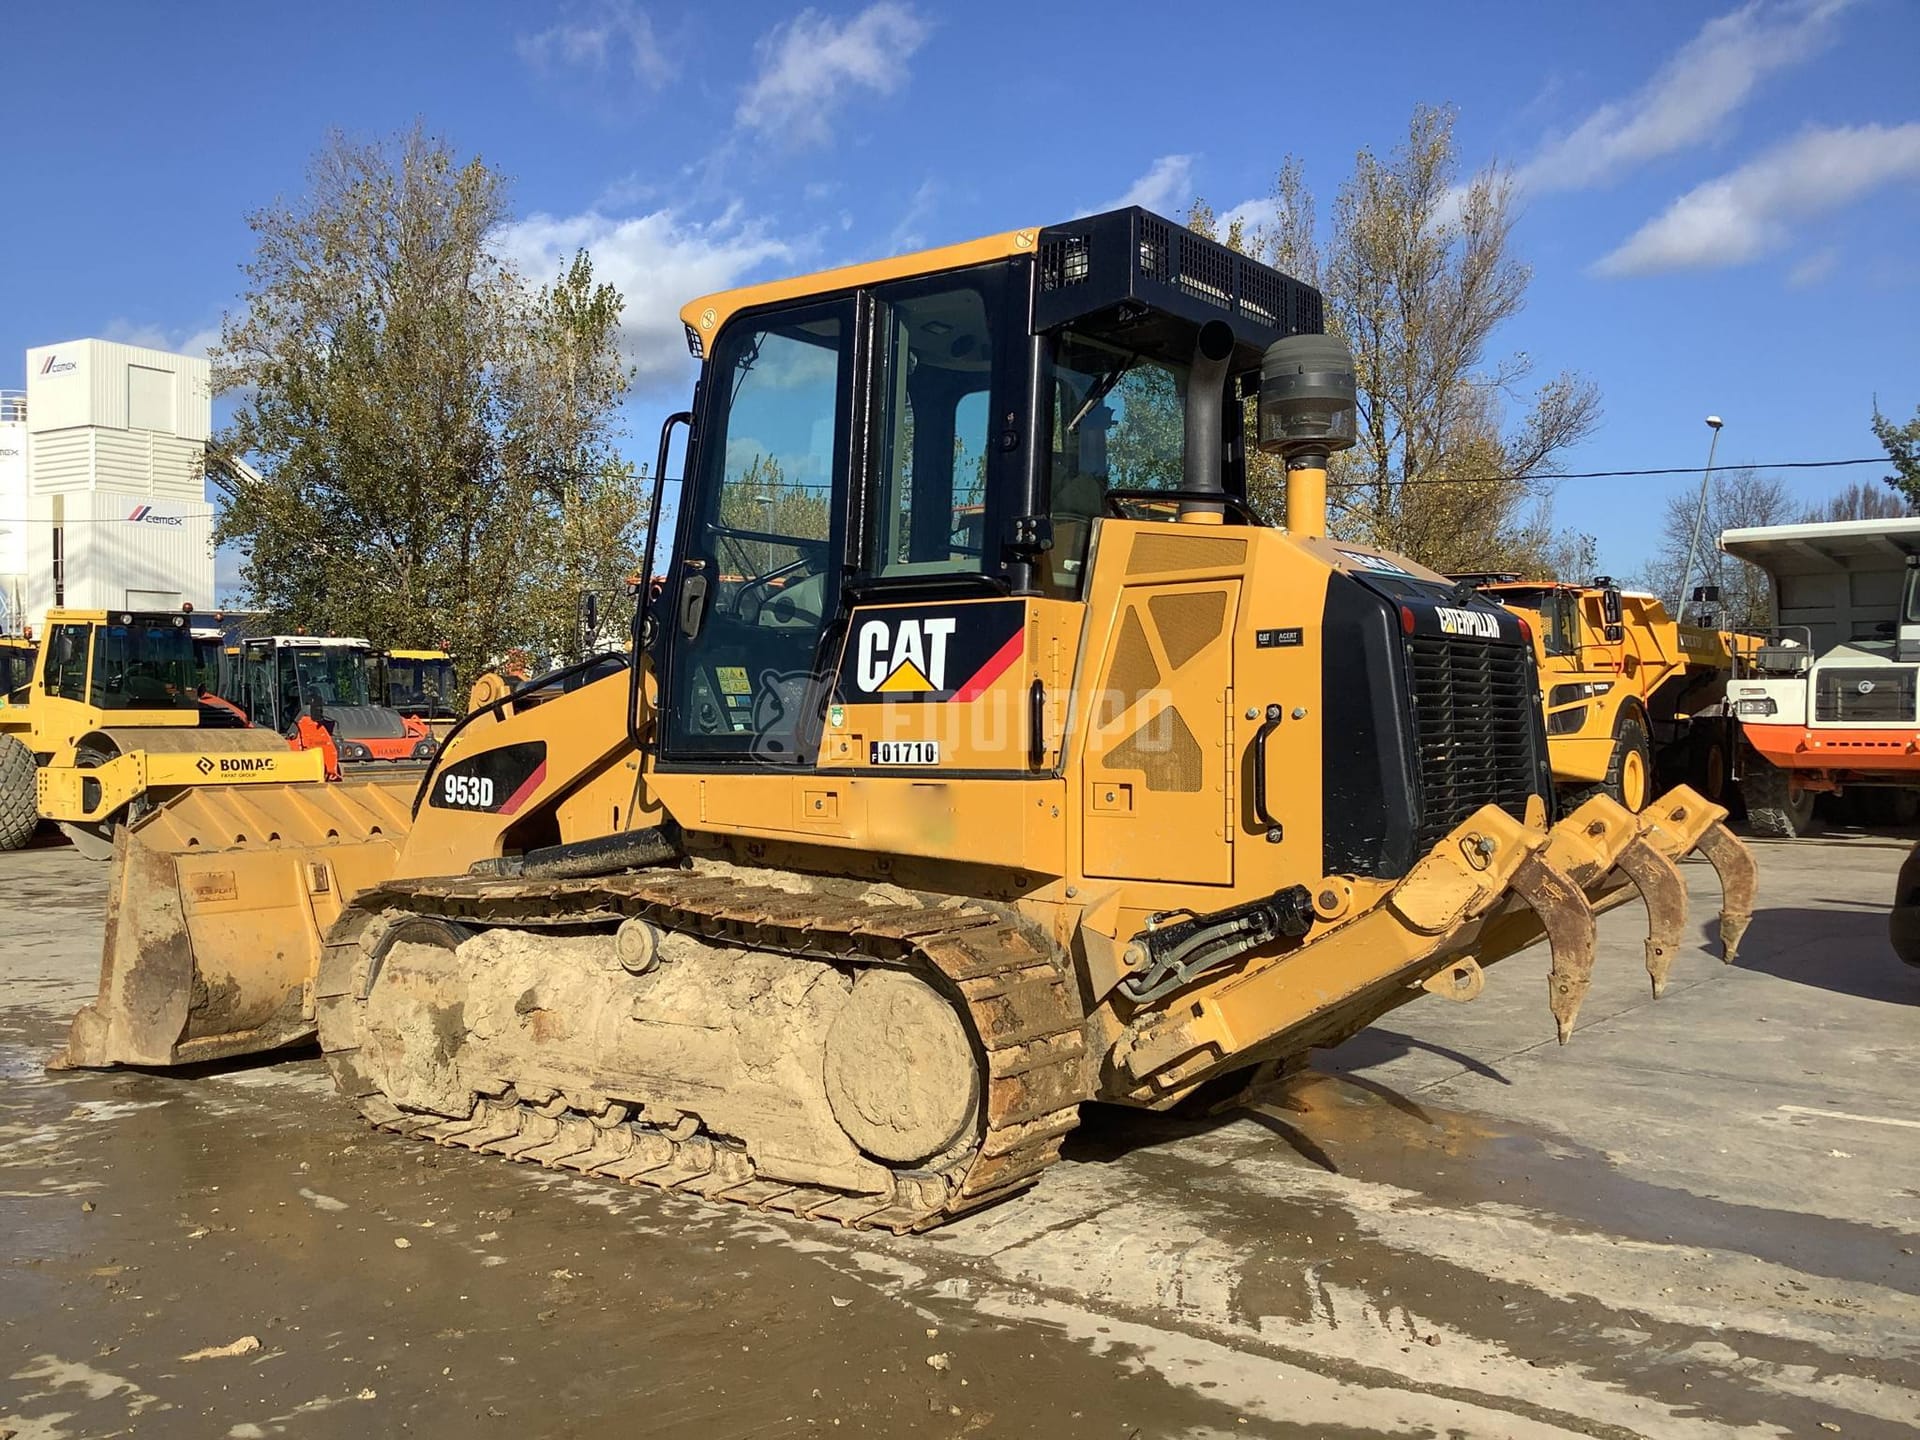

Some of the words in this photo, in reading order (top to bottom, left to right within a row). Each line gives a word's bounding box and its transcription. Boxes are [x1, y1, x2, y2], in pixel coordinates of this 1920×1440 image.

[1258, 633, 1270, 641] CAT
[1434, 606, 1500, 639] CATERPILLAR
[857, 618, 956, 693] CAT
[882, 743, 935, 763] 01710
[445, 774, 493, 807] 953D
